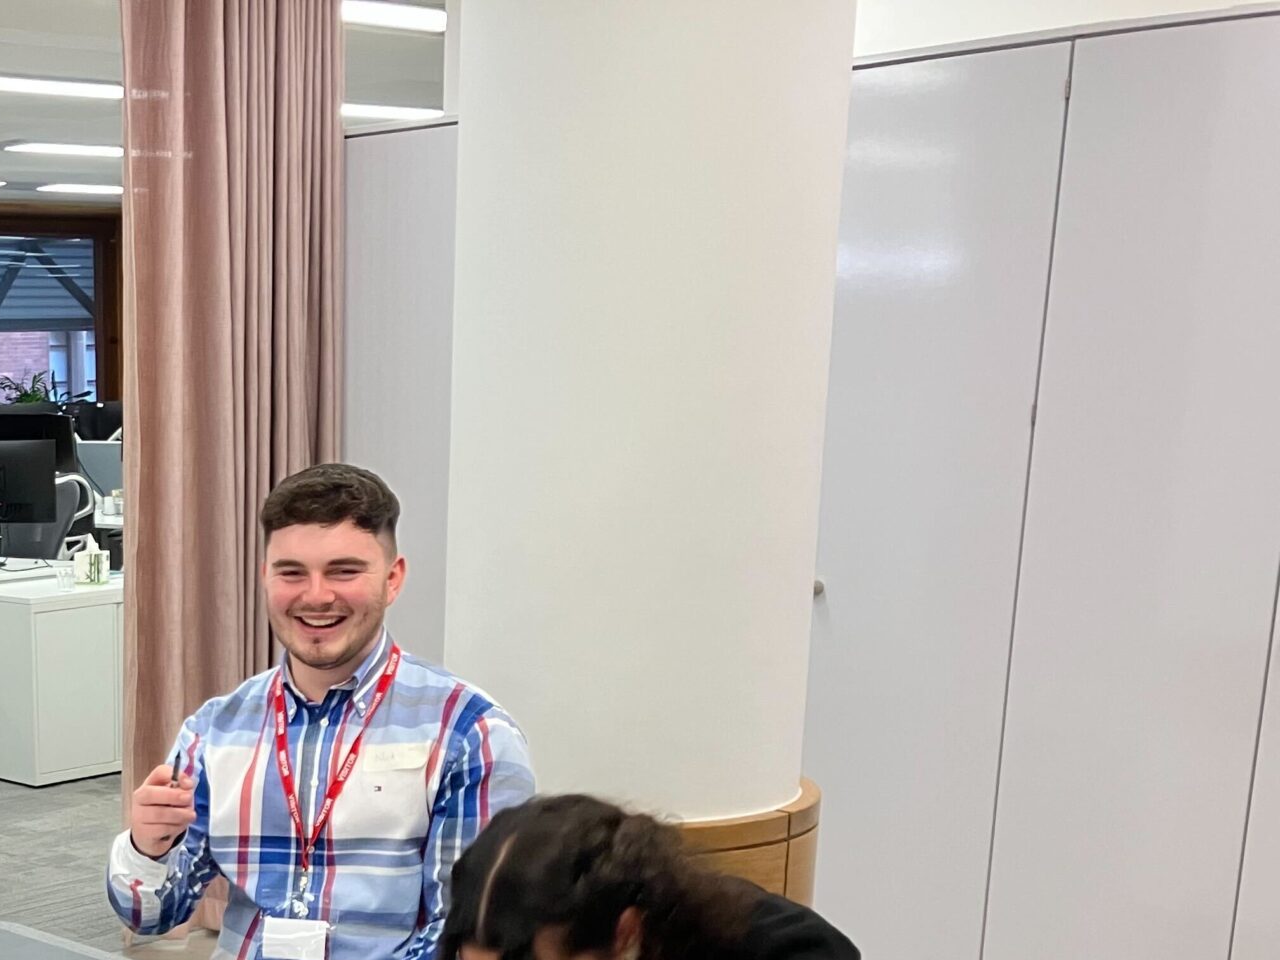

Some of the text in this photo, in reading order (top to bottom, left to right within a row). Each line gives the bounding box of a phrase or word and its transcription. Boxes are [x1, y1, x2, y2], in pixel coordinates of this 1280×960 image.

[337, 753, 357, 782] VISITOR
[288, 795, 300, 824] VISITOR
[316, 798, 332, 827] VISITOR
